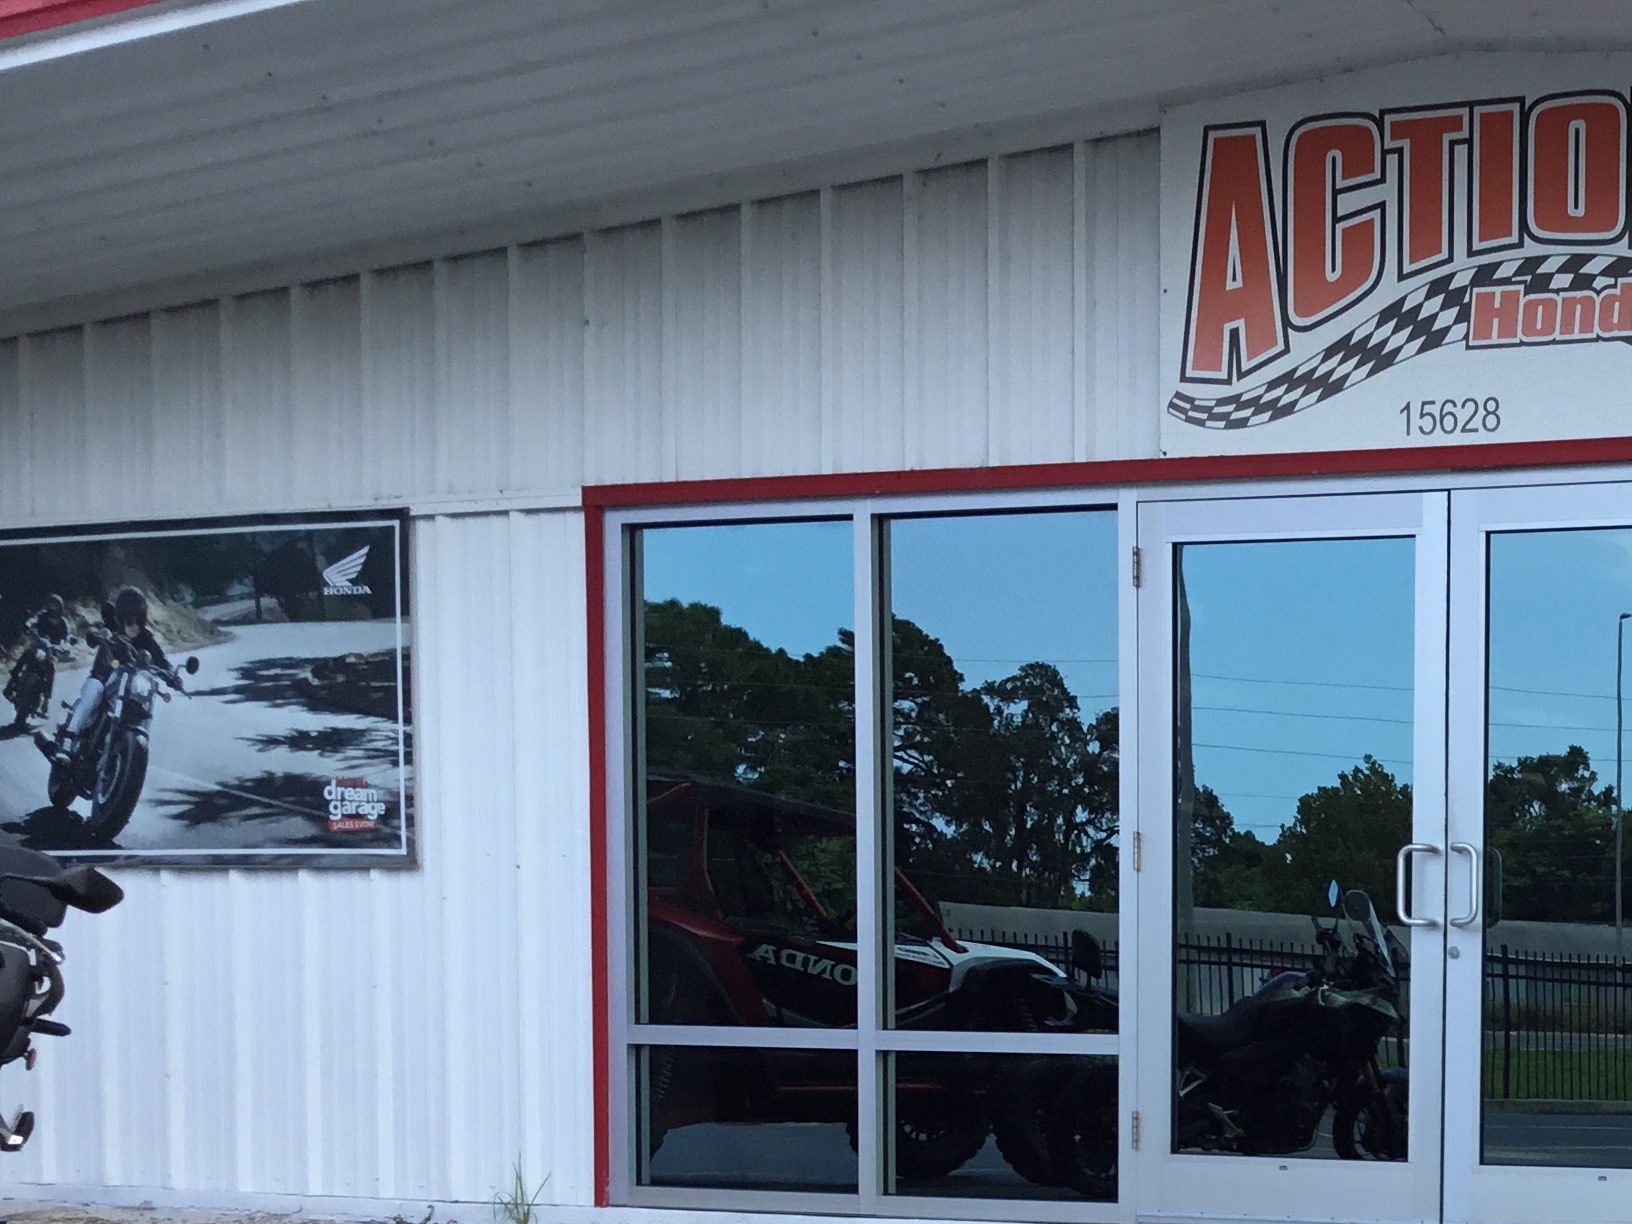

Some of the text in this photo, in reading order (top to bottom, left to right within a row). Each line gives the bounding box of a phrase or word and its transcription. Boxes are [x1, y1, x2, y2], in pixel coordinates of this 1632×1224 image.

[1400, 397, 1502, 437] 15628
[323, 585, 373, 596] HONDA
[323, 779, 378, 802] dream
[328, 800, 387, 821] garage
